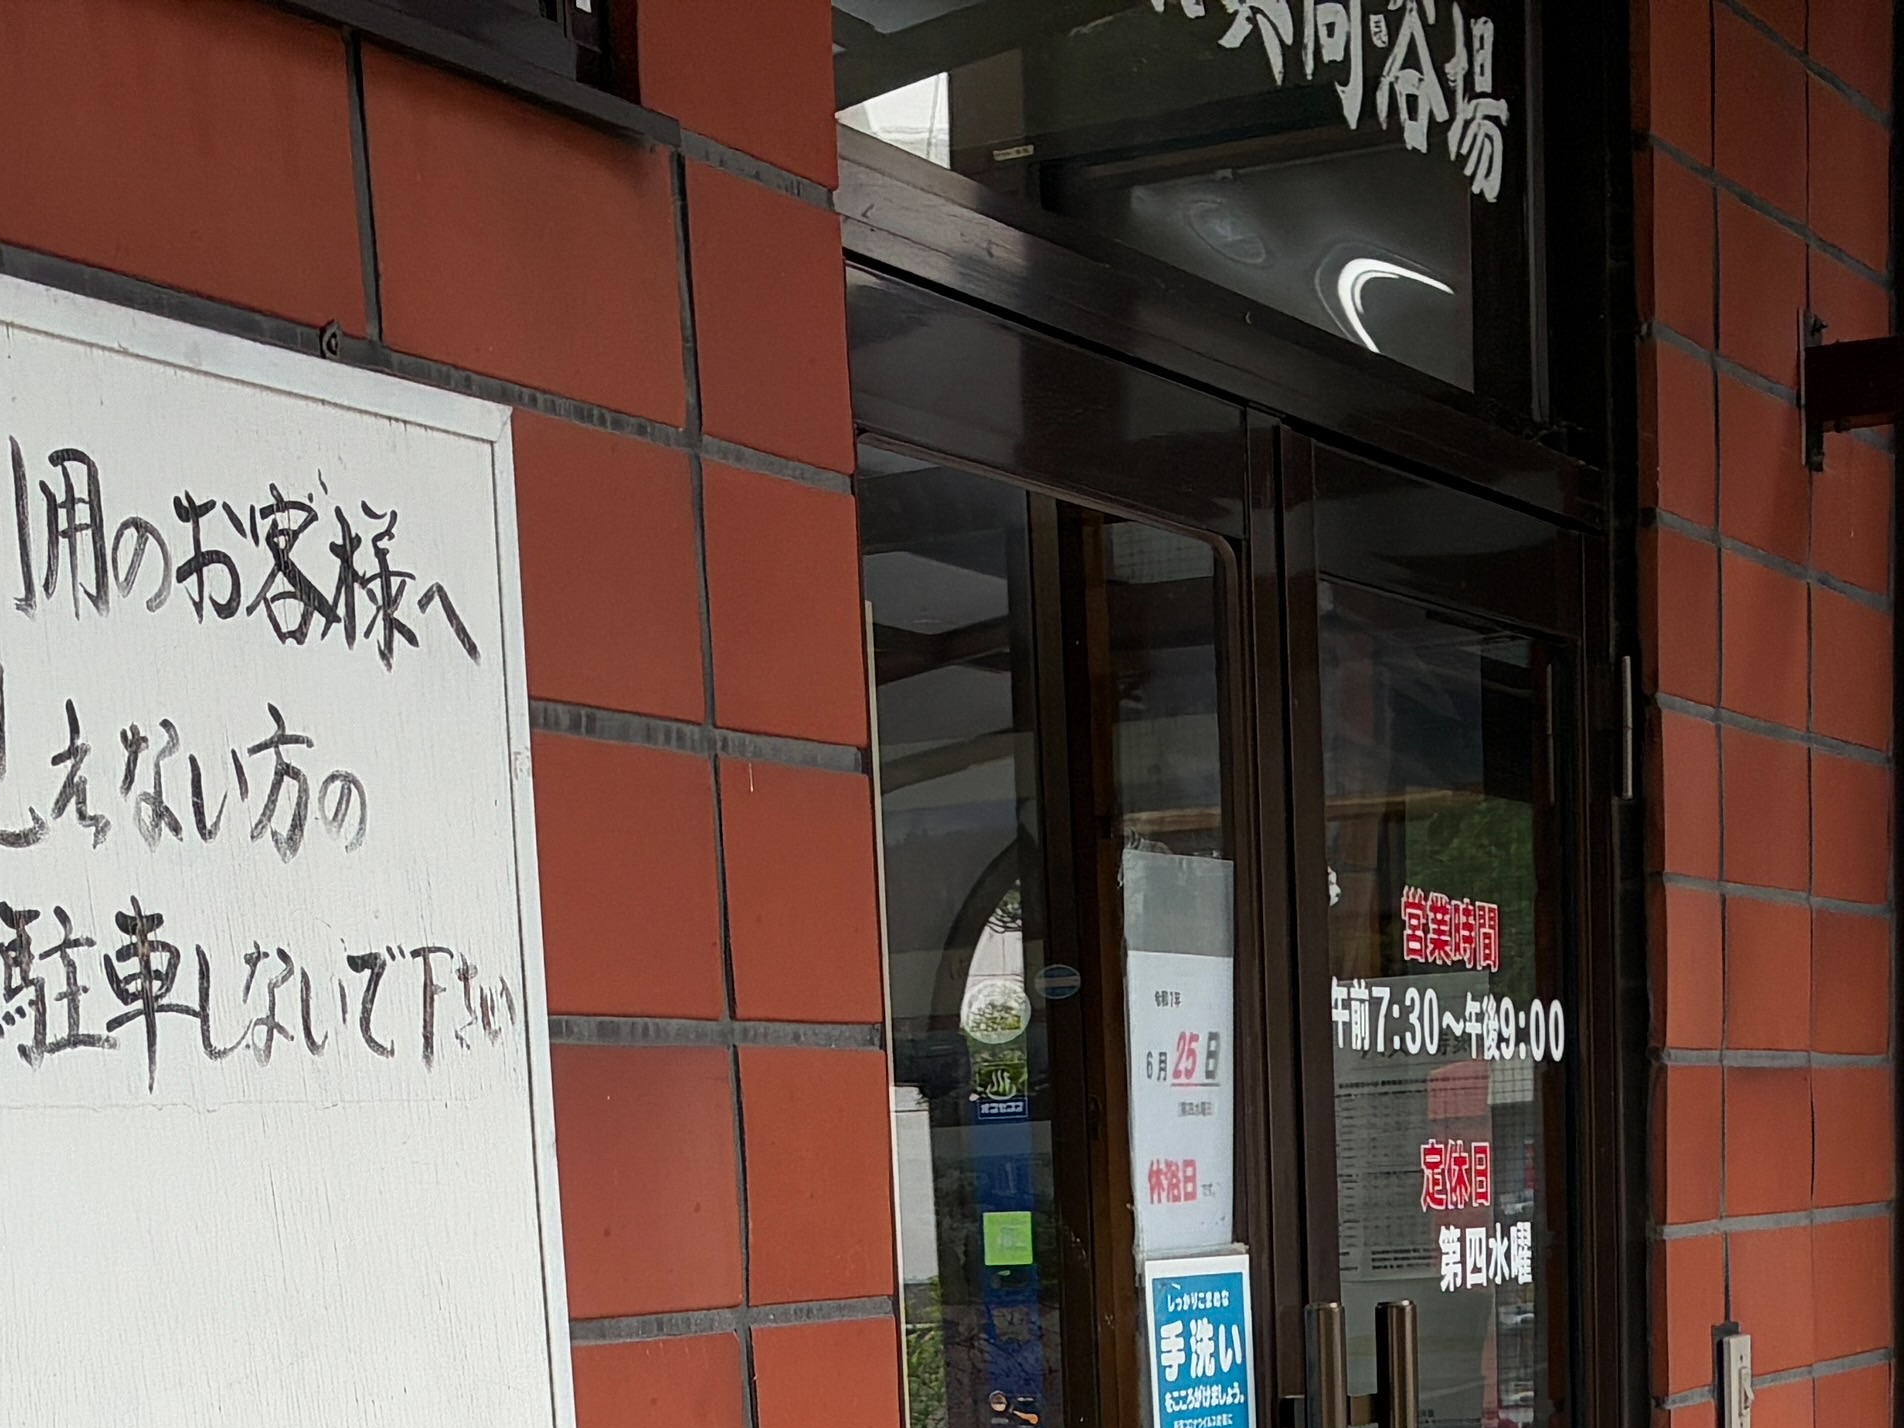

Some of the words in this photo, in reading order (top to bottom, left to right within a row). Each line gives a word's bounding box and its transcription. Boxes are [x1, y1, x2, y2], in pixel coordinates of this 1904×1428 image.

[1401, 885, 1498, 972] 営業時間
[1420, 1139, 1491, 1212] 定休日
[1439, 1222, 1533, 1292] 第四水曜
[1168, 1290, 1229, 1312] しっかりこまめな
[1160, 1318, 1243, 1382] 手洗い
